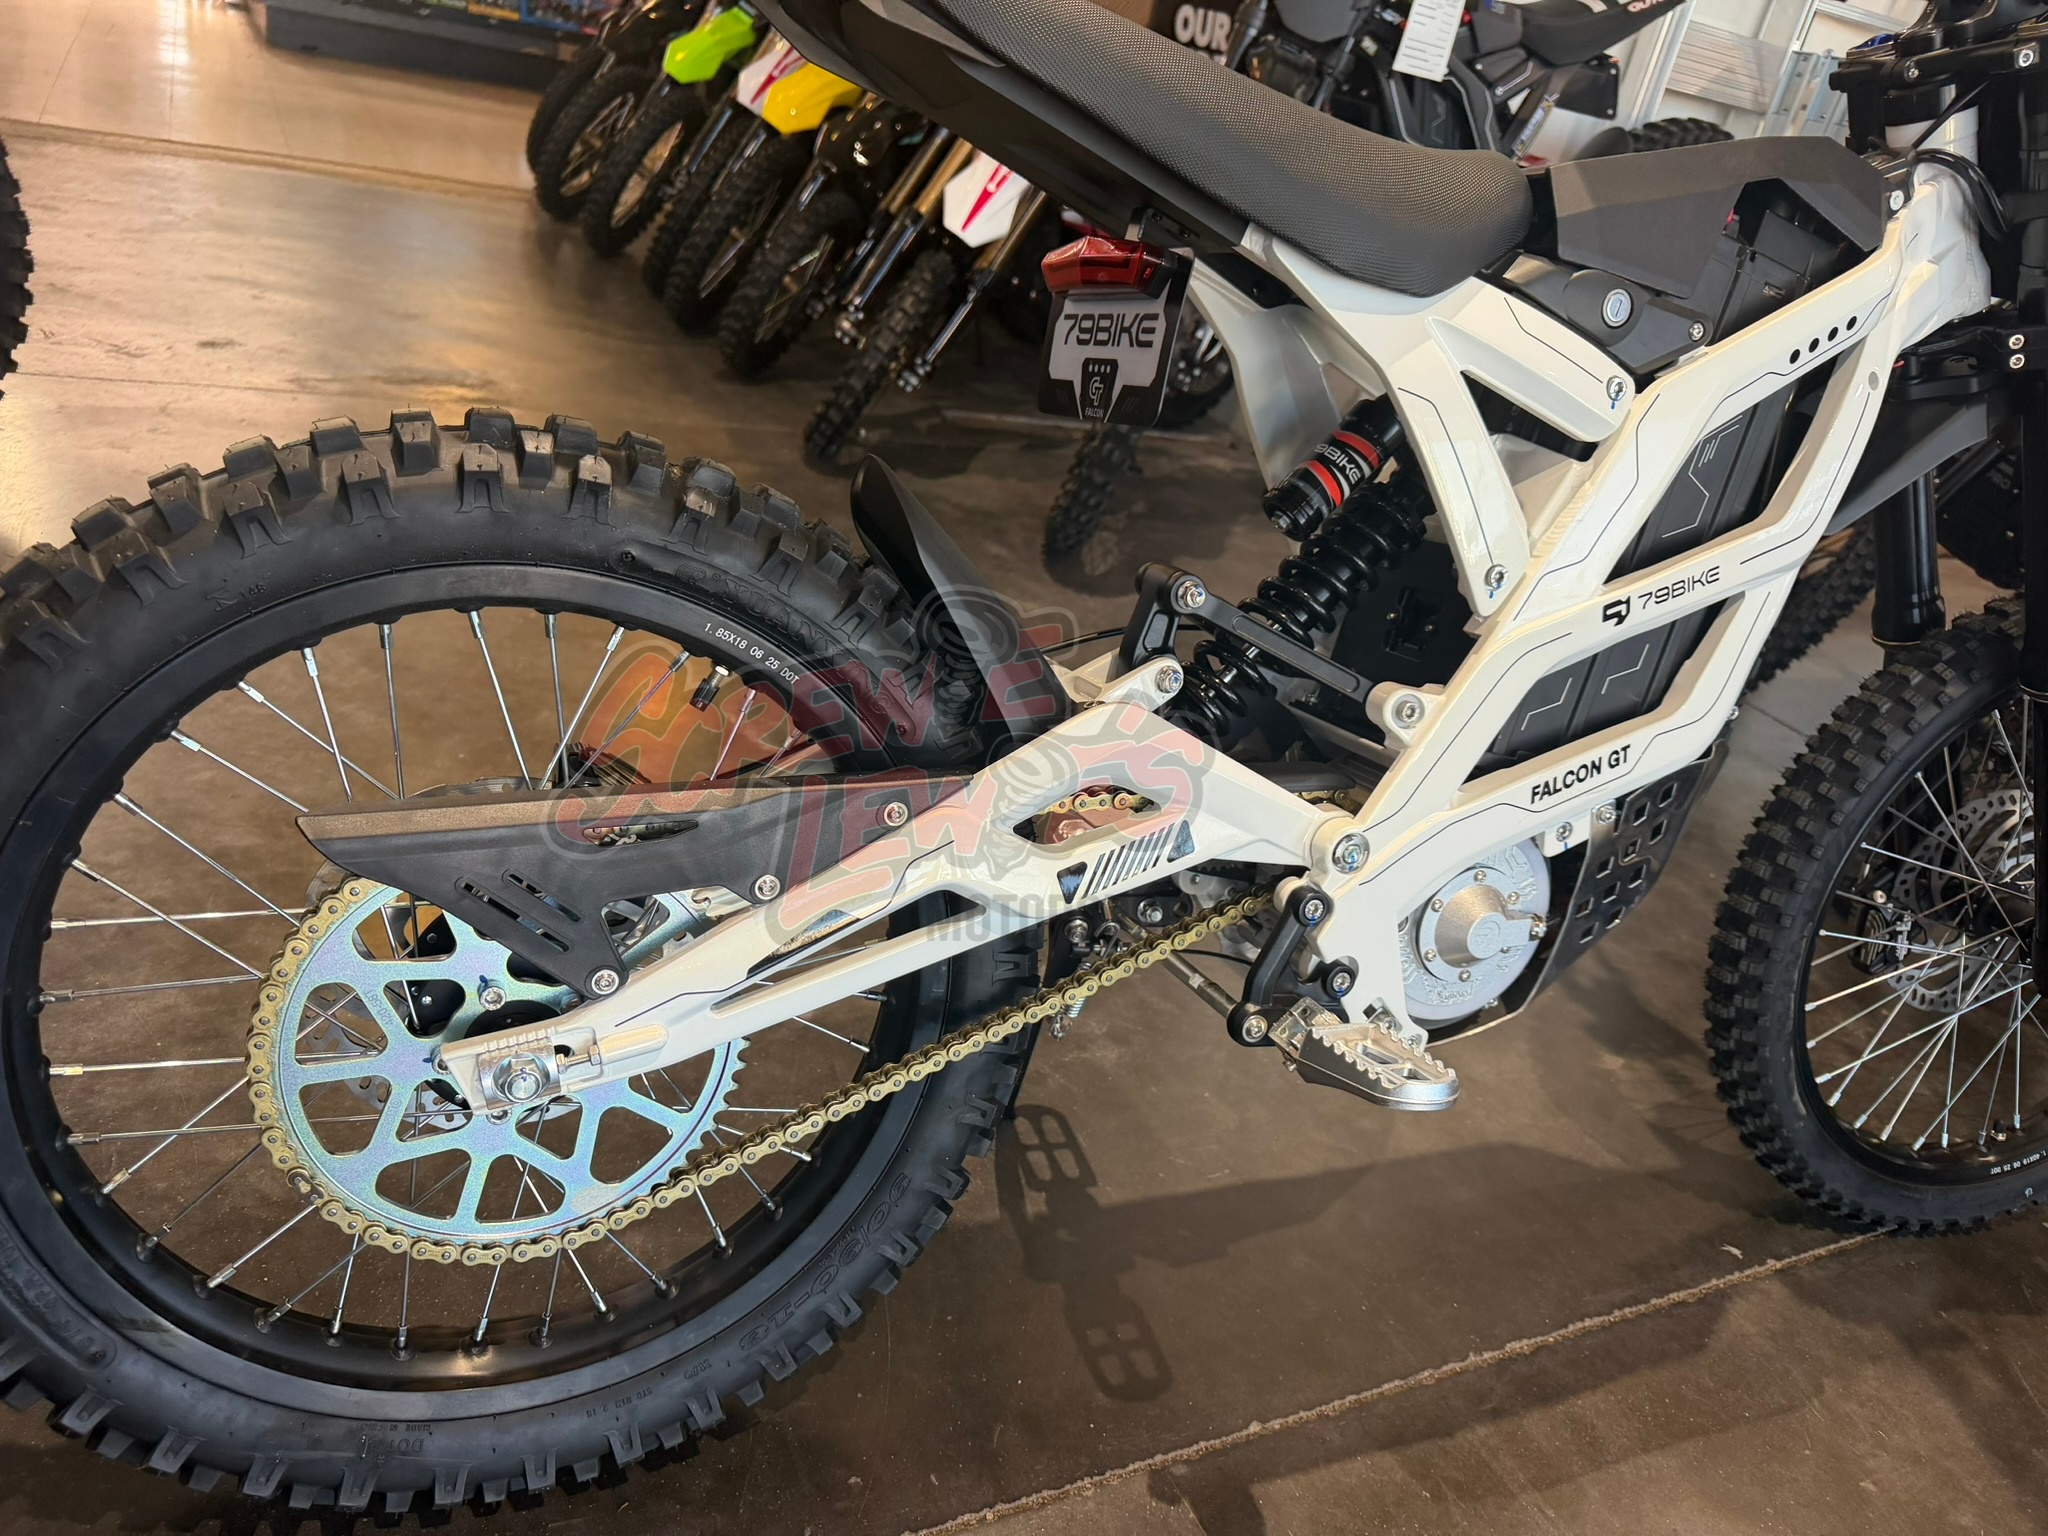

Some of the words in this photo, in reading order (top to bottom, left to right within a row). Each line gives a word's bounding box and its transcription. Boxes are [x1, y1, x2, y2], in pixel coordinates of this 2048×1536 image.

[1174, 4, 1231, 53] OUR
[1063, 313, 1160, 348] 79BIKE
[1084, 407, 1105, 419] FALCON
[1313, 443, 1362, 485] 9BIKE
[1637, 565, 1720, 610] 79BIKE
[749, 646, 765, 660] 06
[765, 656, 780, 670] 25
[780, 667, 800, 684] DOT
[1530, 756, 1603, 805] FALCON
[1607, 743, 1631, 769] GT
